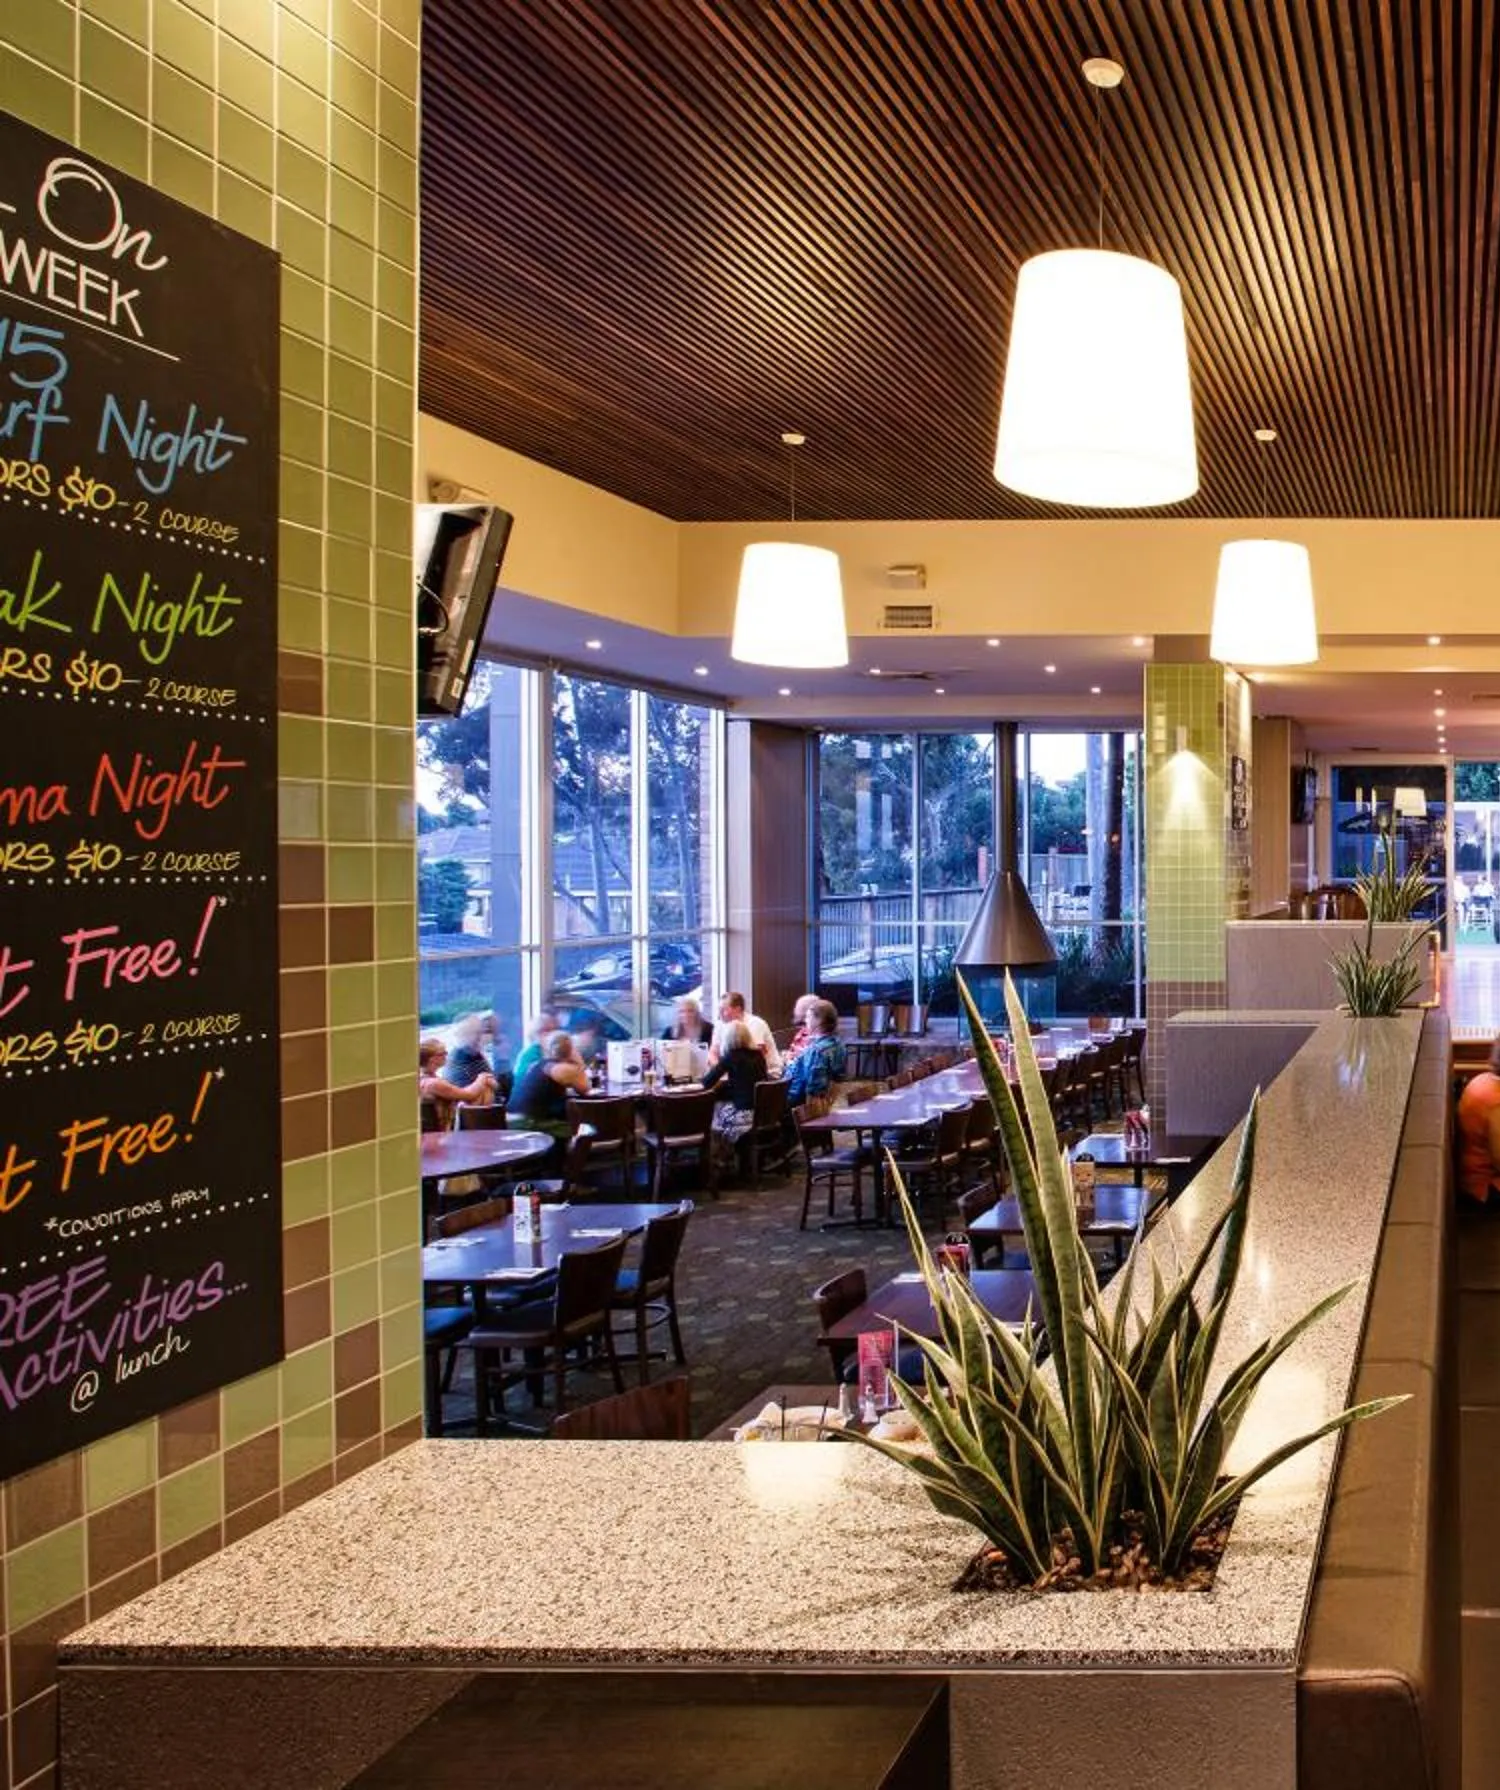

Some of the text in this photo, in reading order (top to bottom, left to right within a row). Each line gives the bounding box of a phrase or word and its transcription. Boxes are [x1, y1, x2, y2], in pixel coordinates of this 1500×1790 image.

[37, 157, 168, 272] On
[0, 229, 144, 338] WEEK
[97, 393, 249, 494] Night
[159, 507, 241, 543] COURSE
[92, 571, 243, 665] Night
[0, 647, 51, 683] RS
[163, 680, 237, 706] COURSE
[89, 739, 246, 840] Night
[0, 842, 56, 873] RS
[162, 850, 241, 873] COURSE
[0, 1031, 58, 1067] RS
[162, 1012, 242, 1042] COURSE
[171, 1187, 210, 1209] APPLY
[115, 1325, 191, 1385] lunch
